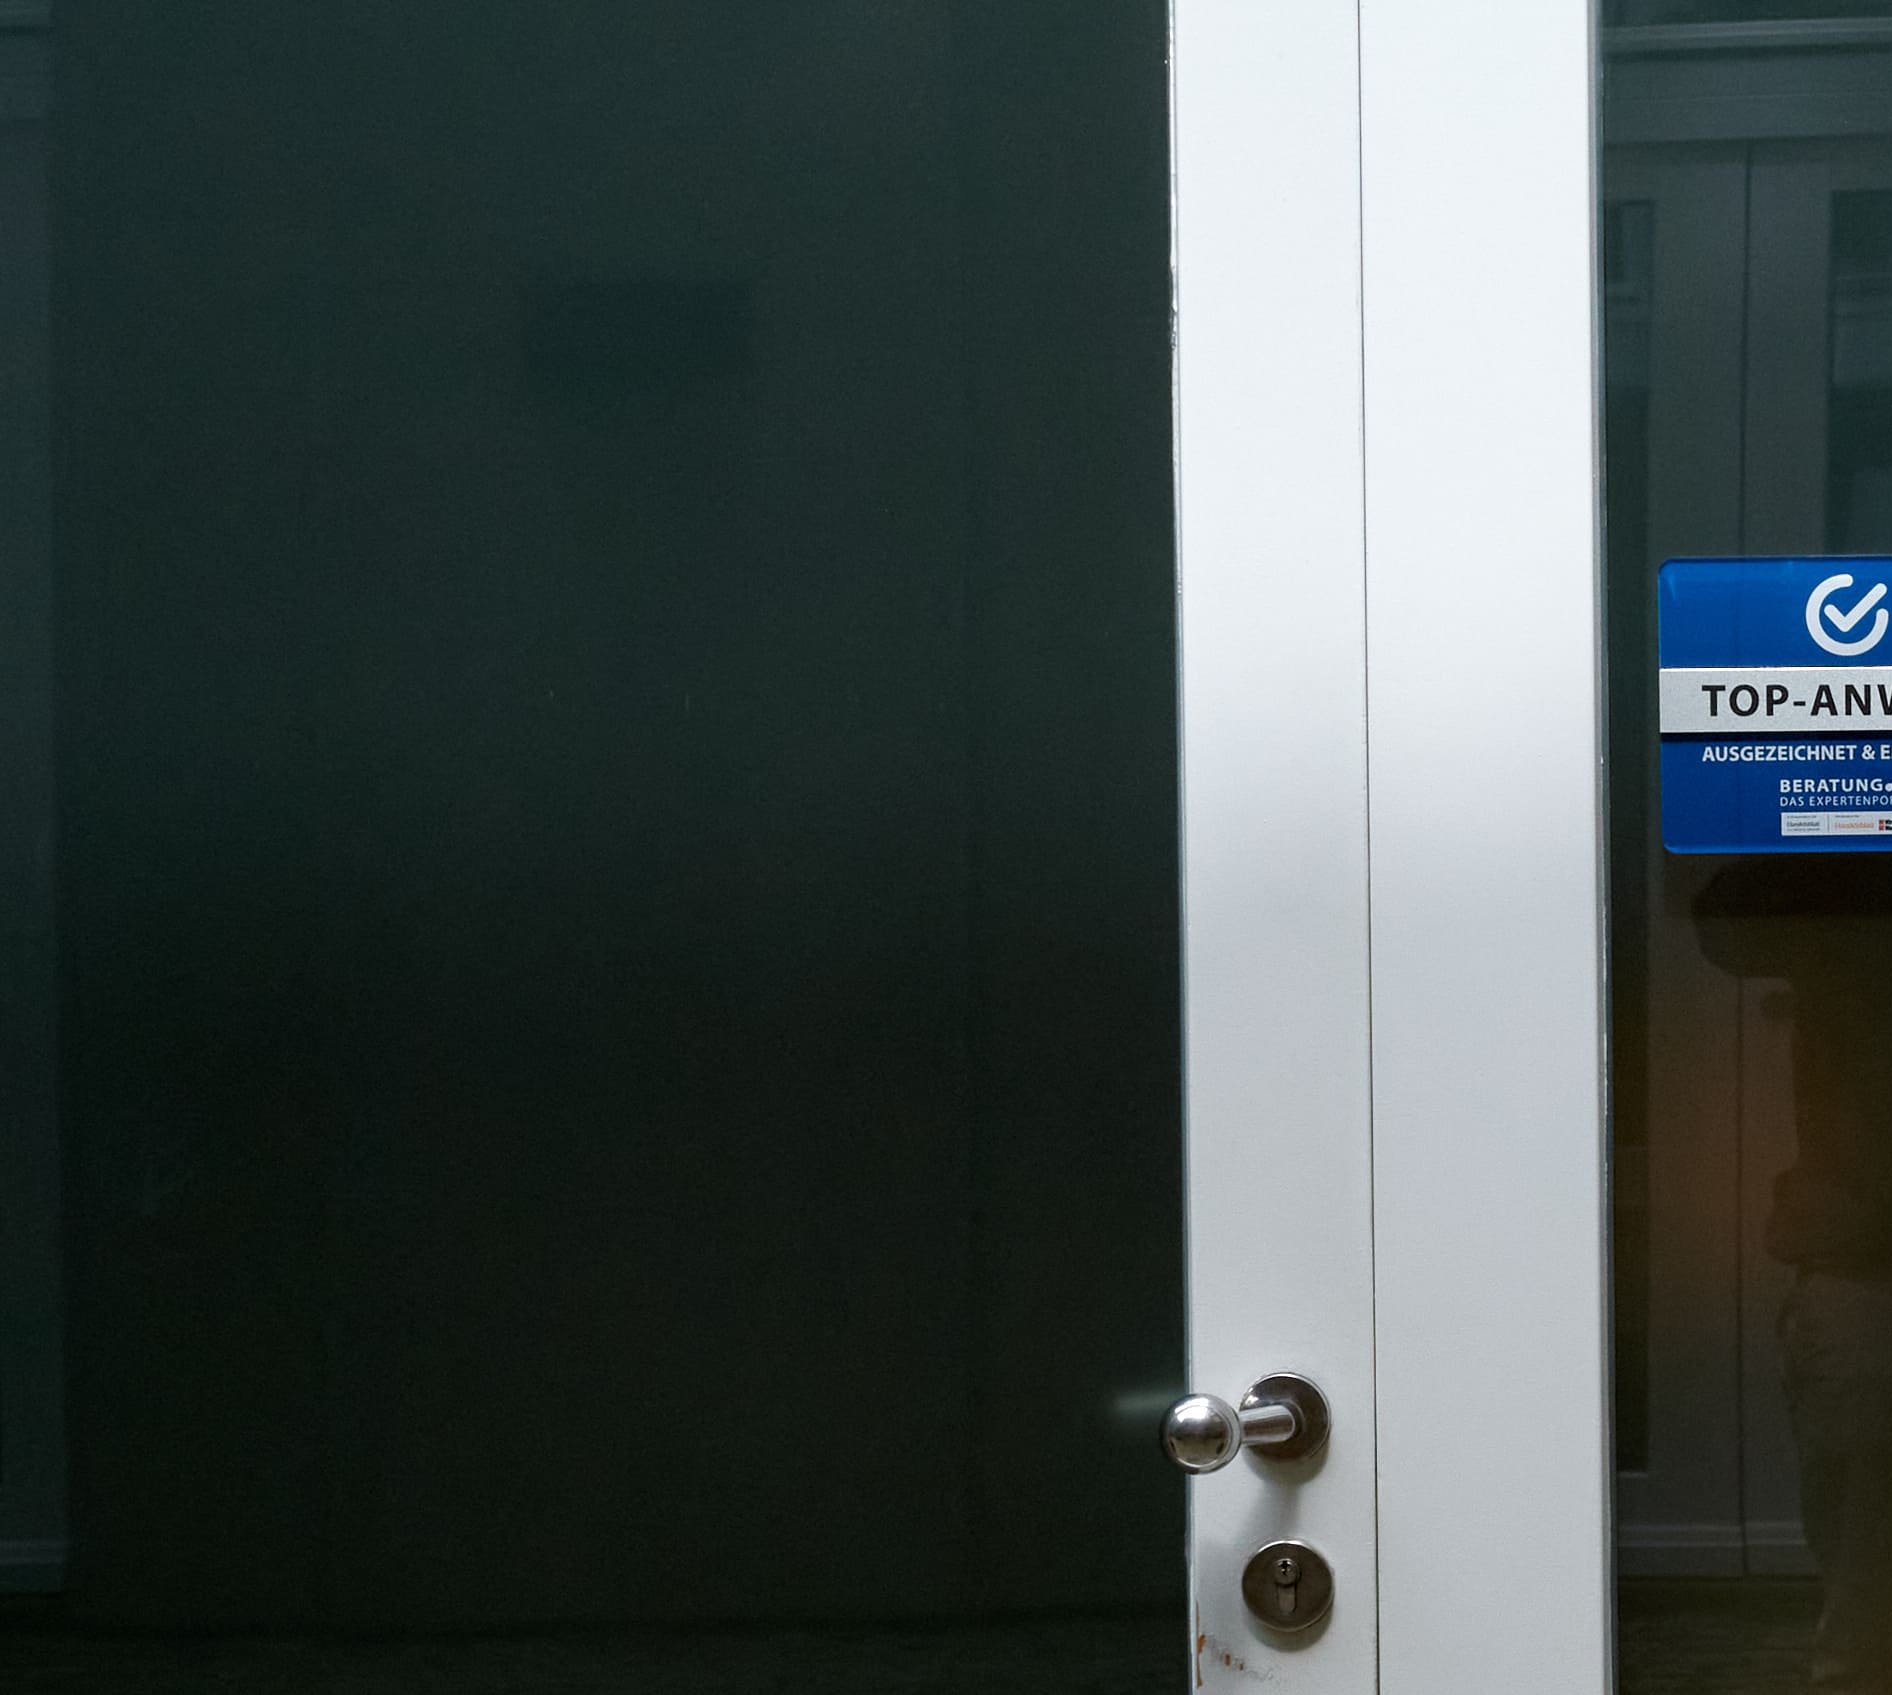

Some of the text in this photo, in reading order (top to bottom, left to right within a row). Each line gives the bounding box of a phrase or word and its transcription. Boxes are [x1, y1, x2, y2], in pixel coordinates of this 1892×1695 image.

[1703, 745, 1857, 761] AUSGEZEICHNET
[1862, 745, 1875, 759] &
[1781, 797, 1803, 806] DAS
